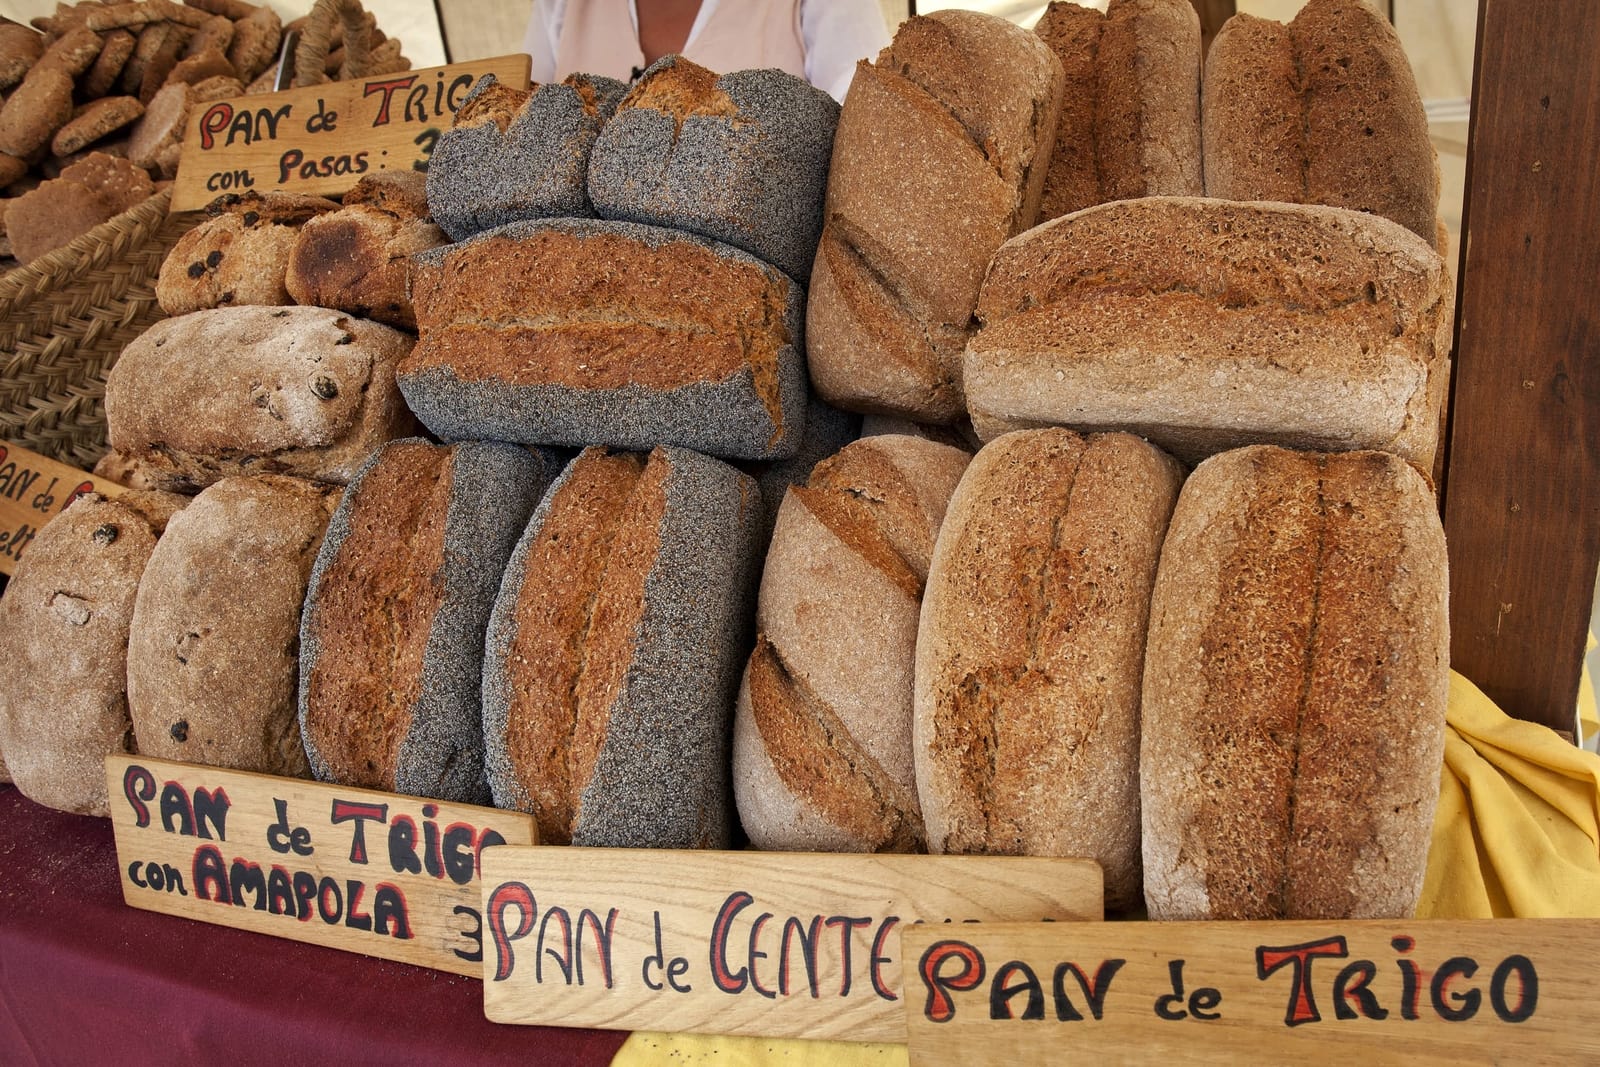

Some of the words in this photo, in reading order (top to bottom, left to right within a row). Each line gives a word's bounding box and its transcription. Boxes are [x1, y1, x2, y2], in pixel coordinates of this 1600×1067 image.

[200, 102, 292, 150] PAN
[305, 98, 338, 134] de
[363, 71, 497, 128] TRiG
[206, 167, 255, 192] con
[32, 477, 58, 514] de
[123, 764, 232, 842] PAN
[267, 796, 315, 856] de
[128, 860, 188, 896] con
[191, 843, 415, 939] AMAPOLA
[488, 881, 619, 989] PAN
[642, 910, 692, 993] de
[918, 939, 1126, 1024] PAN
[1154, 958, 1222, 1021] de
